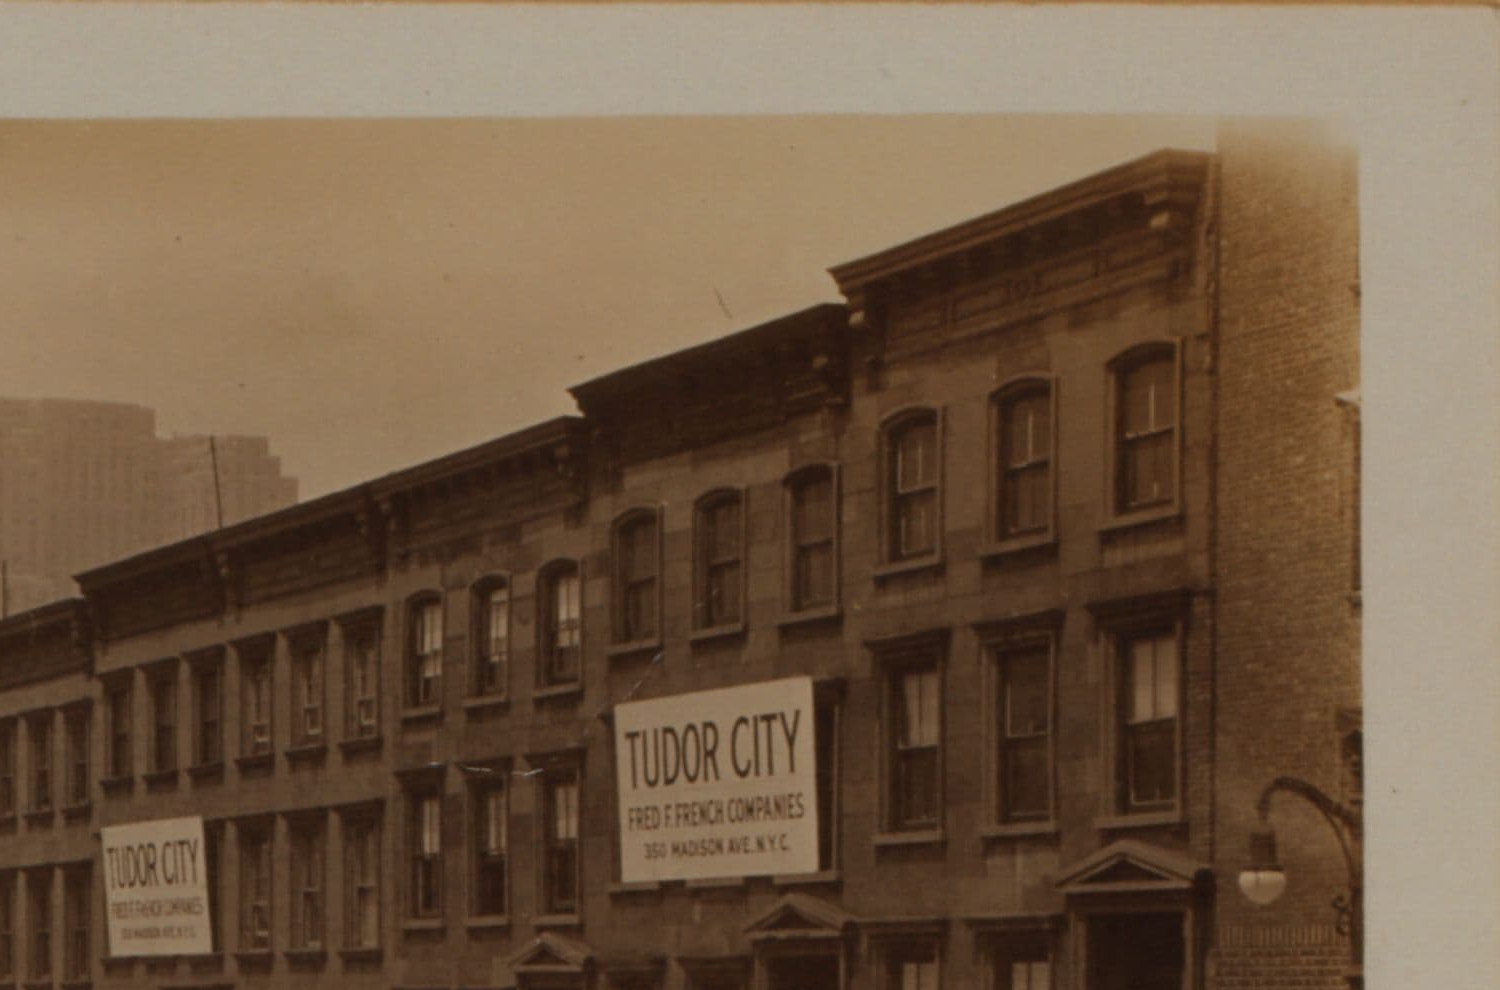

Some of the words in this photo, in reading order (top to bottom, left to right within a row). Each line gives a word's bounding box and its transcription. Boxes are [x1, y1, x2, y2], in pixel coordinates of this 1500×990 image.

[625, 720, 720, 790] TUDOR
[731, 709, 802, 778] CITY
[628, 804, 660, 831] FRED
[675, 799, 724, 828] FRENCH
[727, 792, 805, 824] COMPANIES
[106, 843, 159, 889] TUDOR
[162, 837, 198, 884] CITY
[671, 838, 724, 859] MADISON
